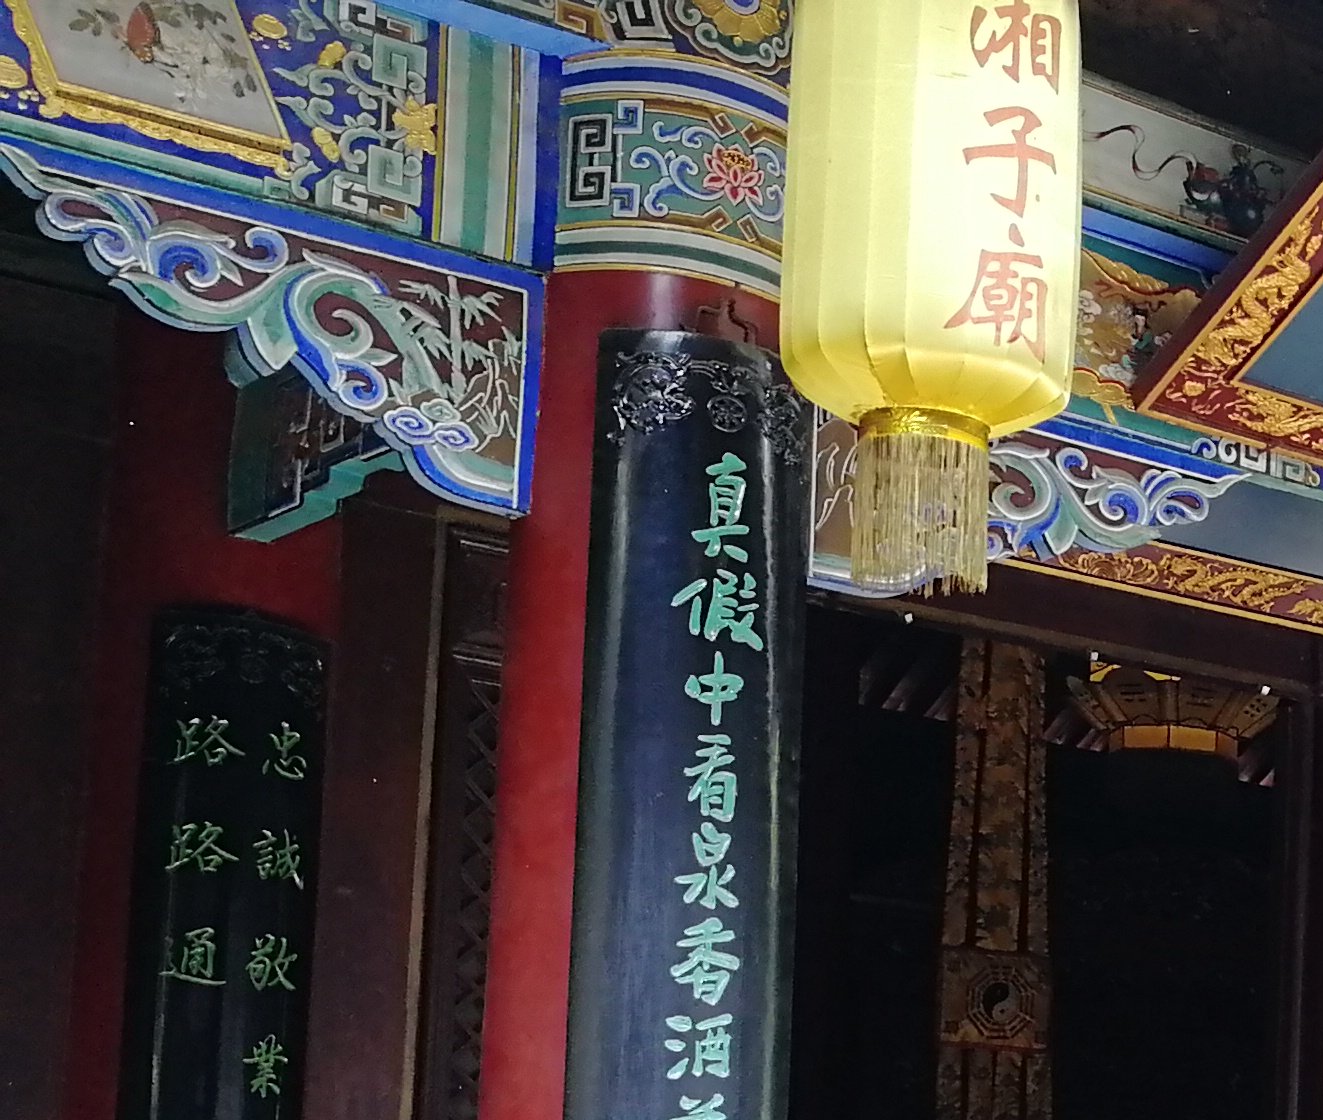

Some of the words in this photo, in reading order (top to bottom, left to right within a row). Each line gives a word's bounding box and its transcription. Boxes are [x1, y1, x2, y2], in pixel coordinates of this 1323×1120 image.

[943, 0, 1062, 365] 湘子廟
[165, 714, 245, 987] 路路通
